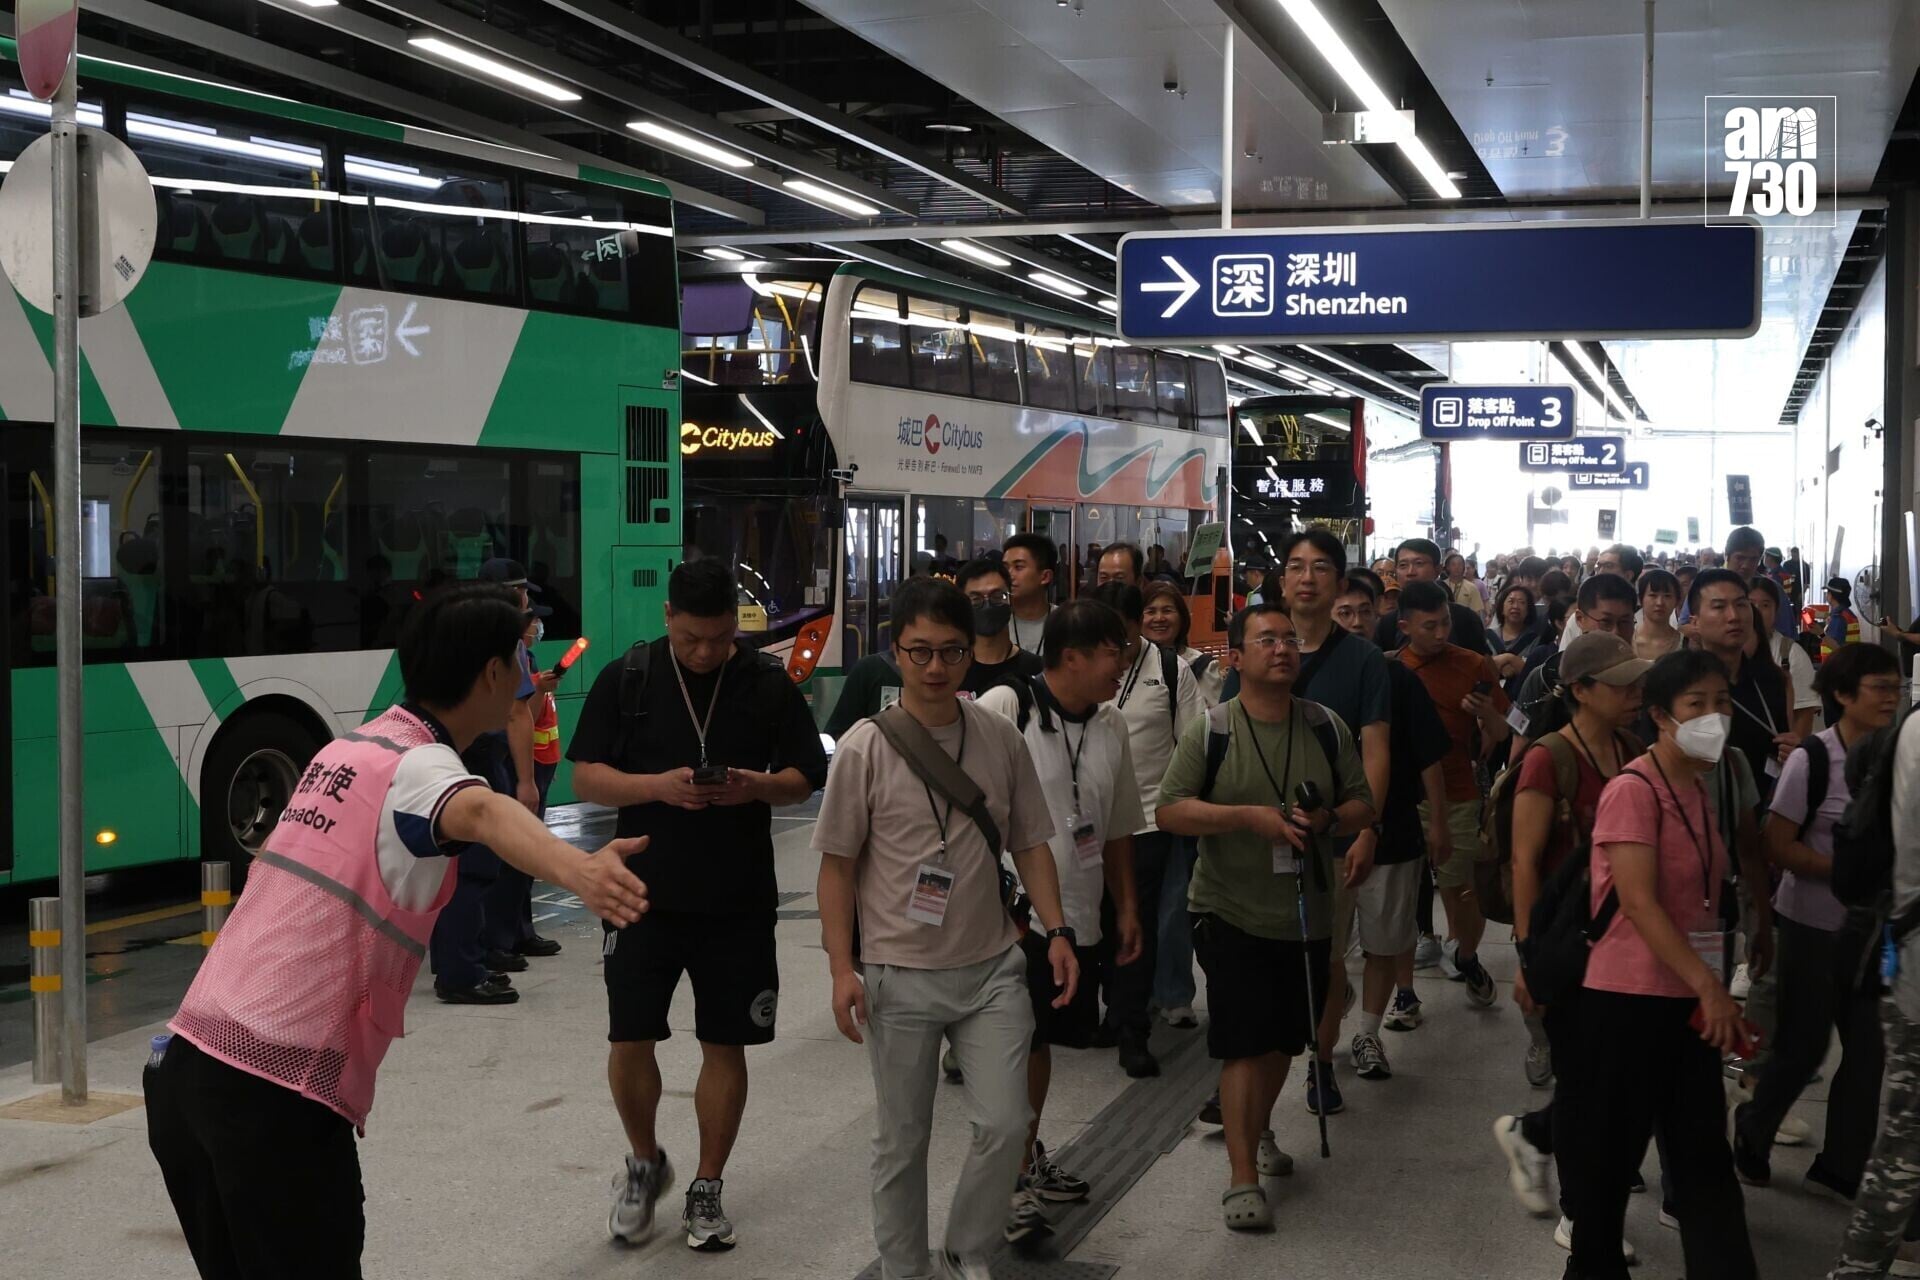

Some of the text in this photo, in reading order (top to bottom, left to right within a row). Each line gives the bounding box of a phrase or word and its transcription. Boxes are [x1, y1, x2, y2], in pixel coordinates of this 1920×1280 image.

[1286, 251, 1356, 288] 深圳
[1220, 263, 1266, 308] 深
[1285, 291, 1408, 316] Shenzhen
[1467, 416, 1536, 430] Drop Off Point
[1468, 396, 1562, 428] 落客點 3
[702, 426, 776, 451] Citybus
[897, 415, 983, 450] 城巴 Citybus
[1551, 456, 1598, 466] Drop Off Point
[1601, 443, 1617, 465] 2
[1256, 477, 1325, 492] 暫停服務
[1633, 467, 1642, 485] 1
[299, 762, 357, 803] 務大使
